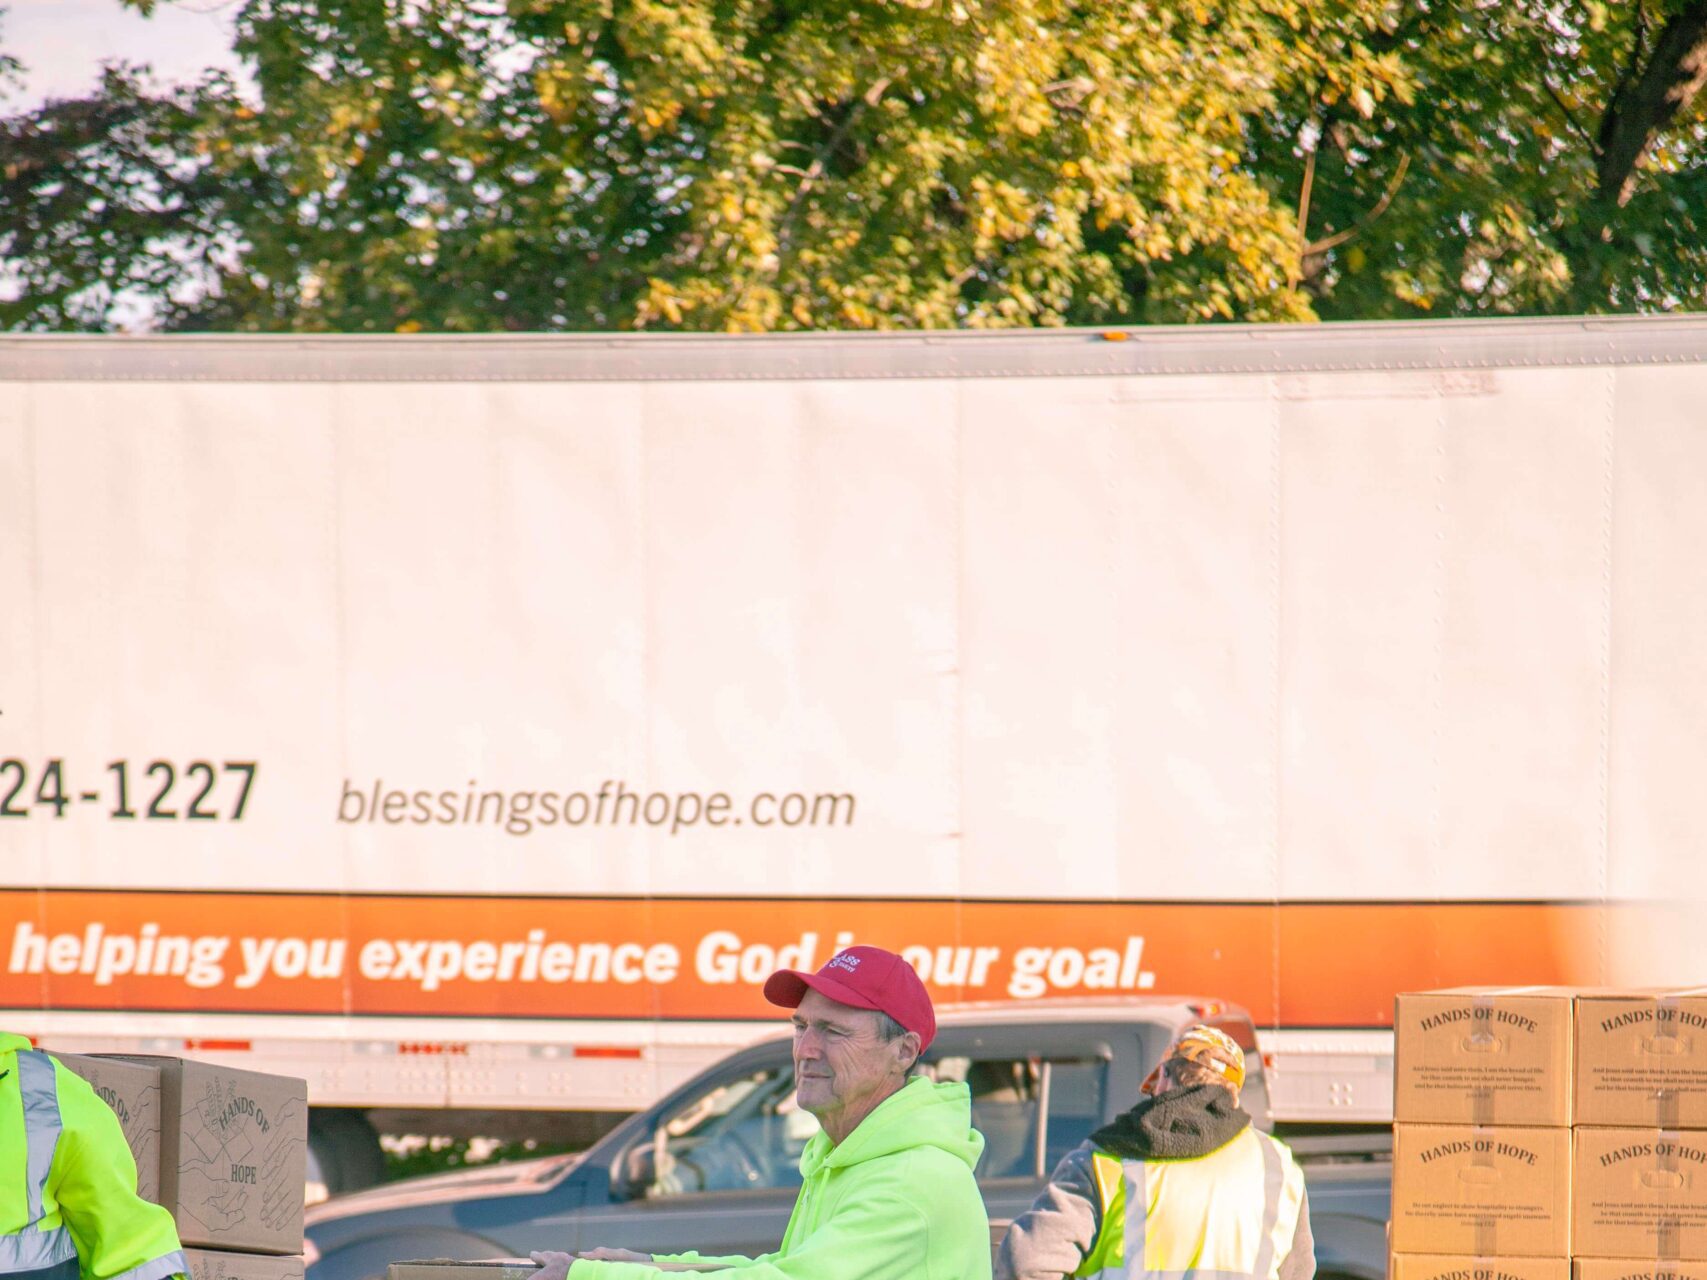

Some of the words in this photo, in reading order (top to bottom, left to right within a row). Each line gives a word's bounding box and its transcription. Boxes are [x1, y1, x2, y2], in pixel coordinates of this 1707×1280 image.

[337, 779, 856, 836] blessingsofhope.com
[9, 923, 229, 986] helping
[235, 940, 348, 988] you
[362, 930, 680, 990] experience
[695, 933, 818, 983] God
[1008, 936, 1156, 997] goal.
[1420, 1009, 1471, 1032] HANDS
[1475, 1008, 1494, 1021] OF
[1496, 1010, 1538, 1032] HOPE
[1601, 1010, 1652, 1032] HANDS
[1657, 1008, 1677, 1022] OF
[218, 1096, 254, 1130] HANDS
[255, 1113, 269, 1134] OF
[1420, 1141, 1471, 1164] HANDS
[1475, 1140, 1494, 1152] OF
[1496, 1143, 1538, 1165] HOPE
[1600, 1144, 1651, 1167] HANDS
[1656, 1143, 1675, 1155] OF
[231, 1164, 256, 1185] HOPE
